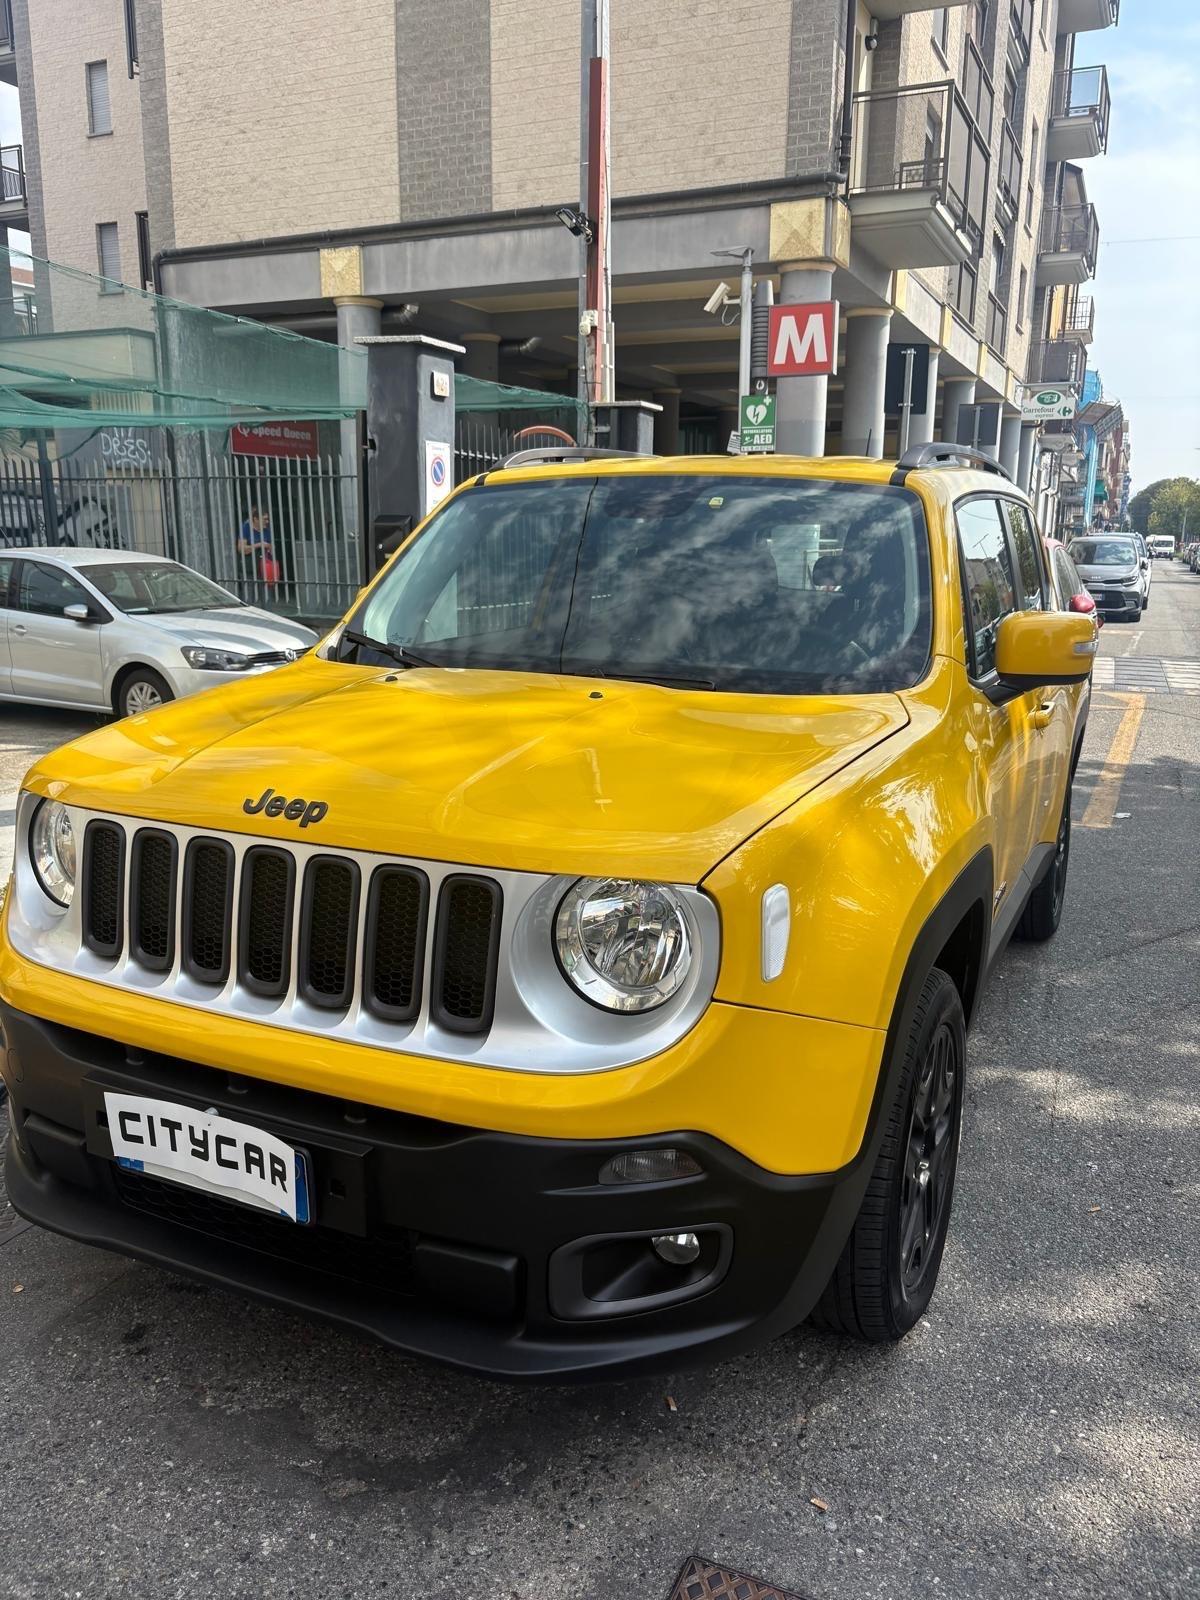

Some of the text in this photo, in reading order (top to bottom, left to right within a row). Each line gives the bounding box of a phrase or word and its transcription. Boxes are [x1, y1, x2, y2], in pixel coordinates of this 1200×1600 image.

[773, 313, 828, 365] M
[1023, 406, 1055, 414] Carrefour
[252, 426, 311, 441] Speed Queen
[753, 434, 772, 445] AED
[243, 788, 329, 828] Jeep
[118, 1110, 289, 1193] CITYCAR
